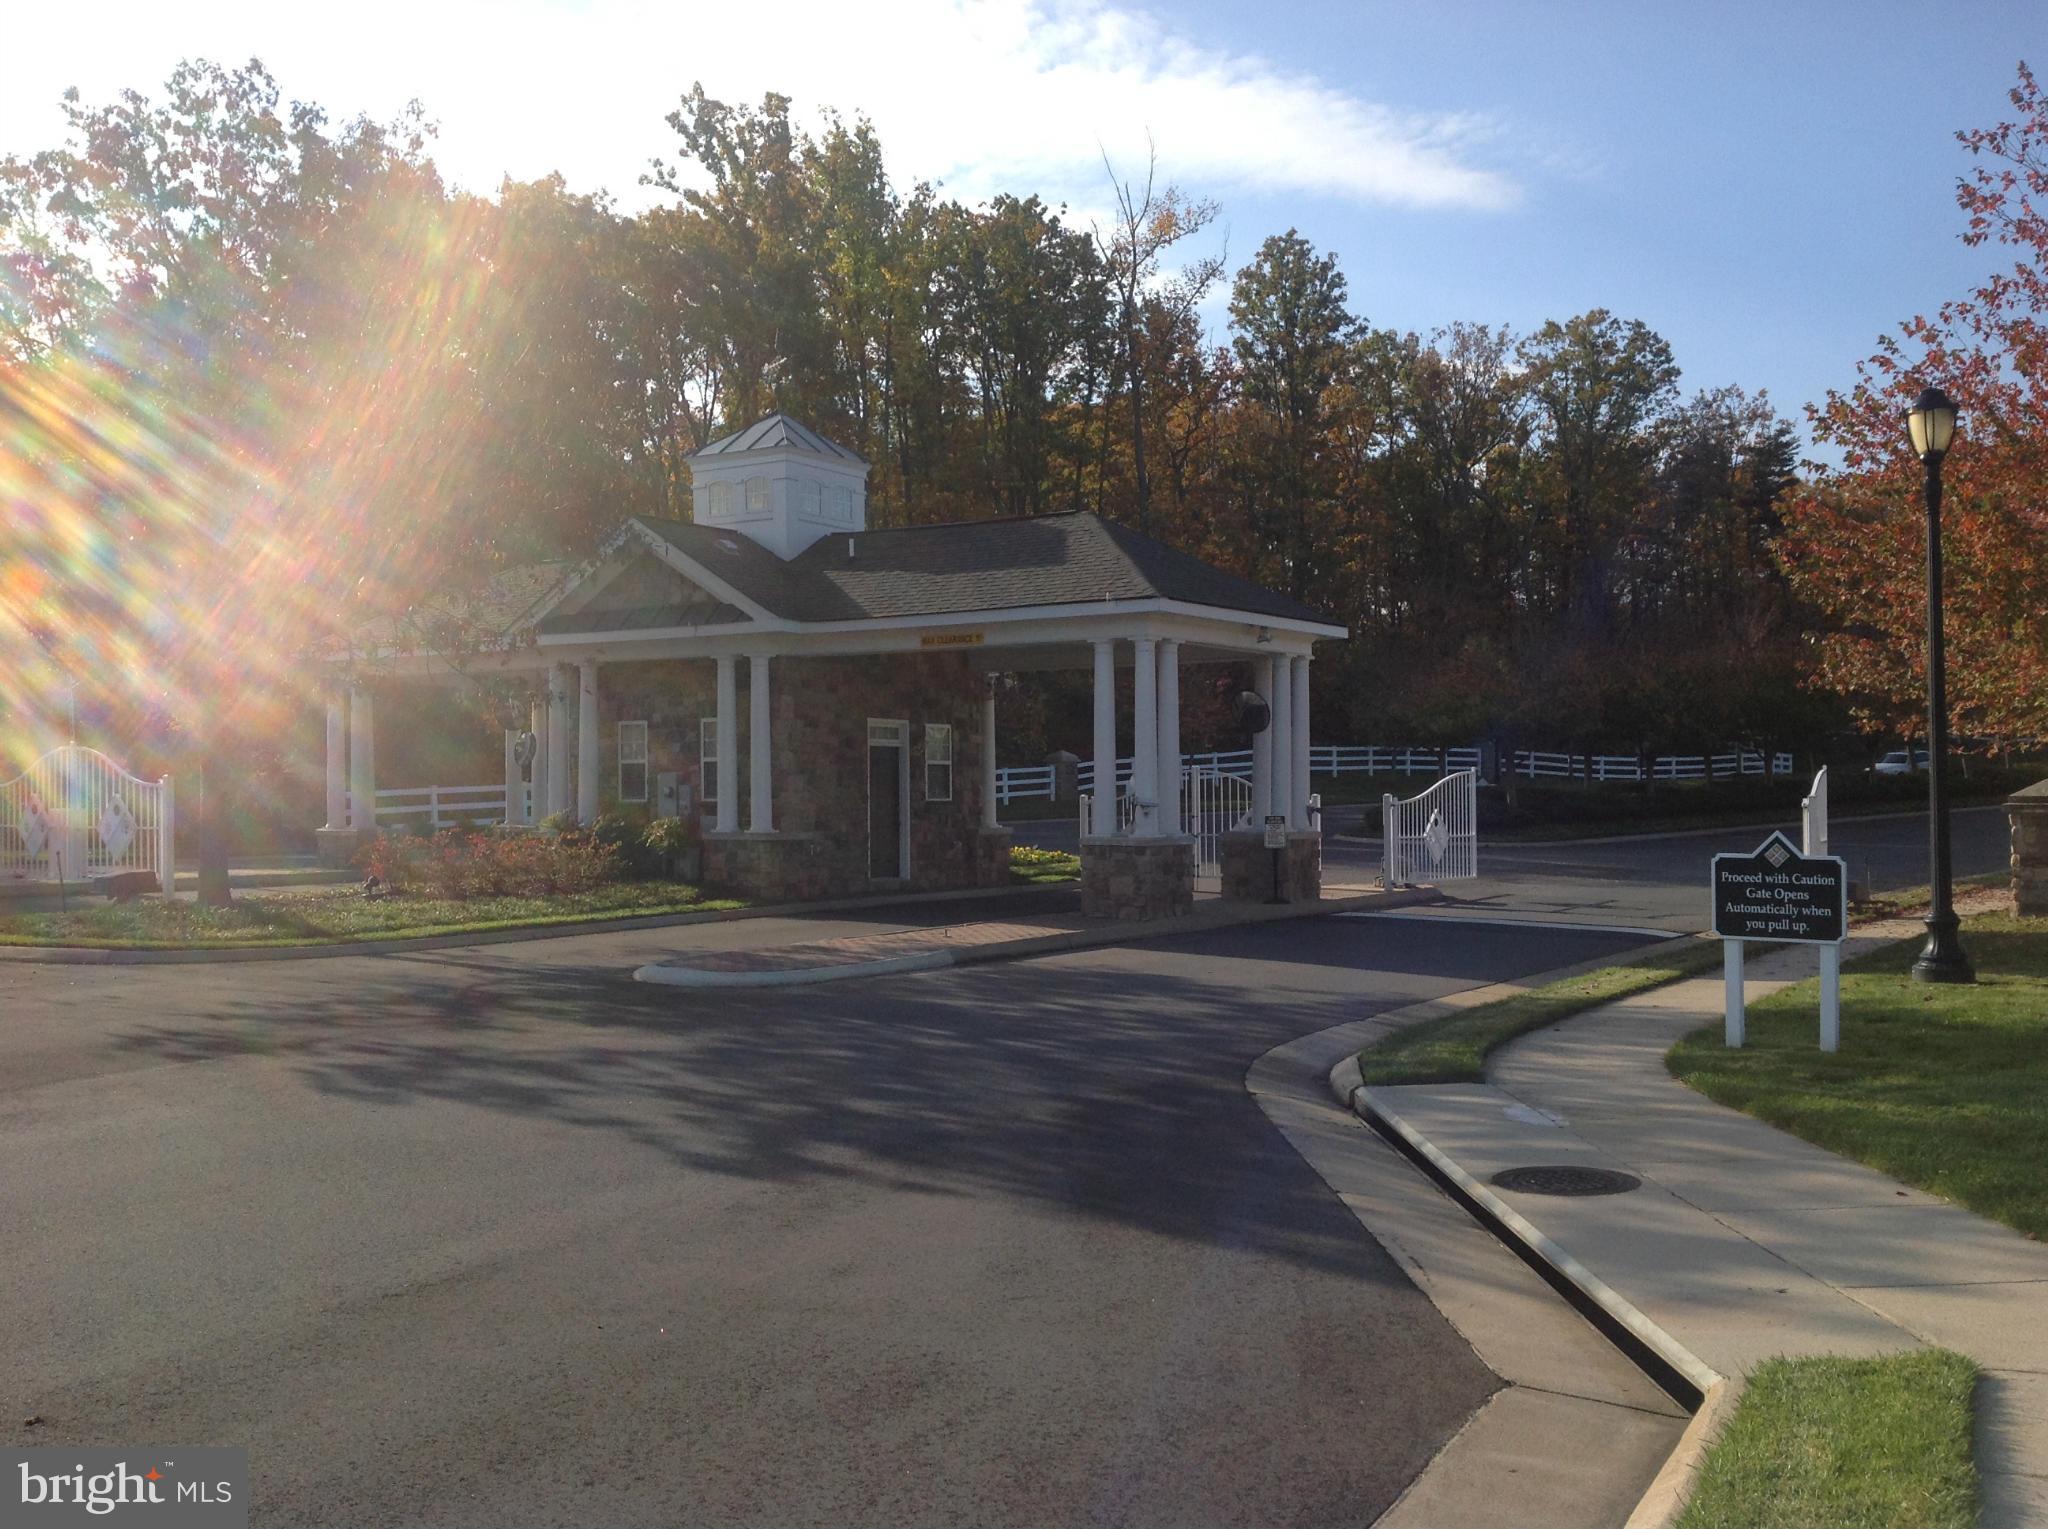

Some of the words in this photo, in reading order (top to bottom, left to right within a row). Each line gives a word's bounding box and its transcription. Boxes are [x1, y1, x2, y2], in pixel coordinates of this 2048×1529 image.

[1721, 872, 1762, 883] Proceed
[1765, 873, 1789, 884] with
[1792, 873, 1835, 885] Caution
[1746, 887, 1772, 899] Gate
[1774, 888, 1810, 902] Opens
[1725, 902, 1799, 918] Automatically
[1801, 905, 1831, 916] when
[1745, 920, 1765, 931] you
[1768, 919, 1789, 932] pull
[1792, 922, 1810, 934] up.
